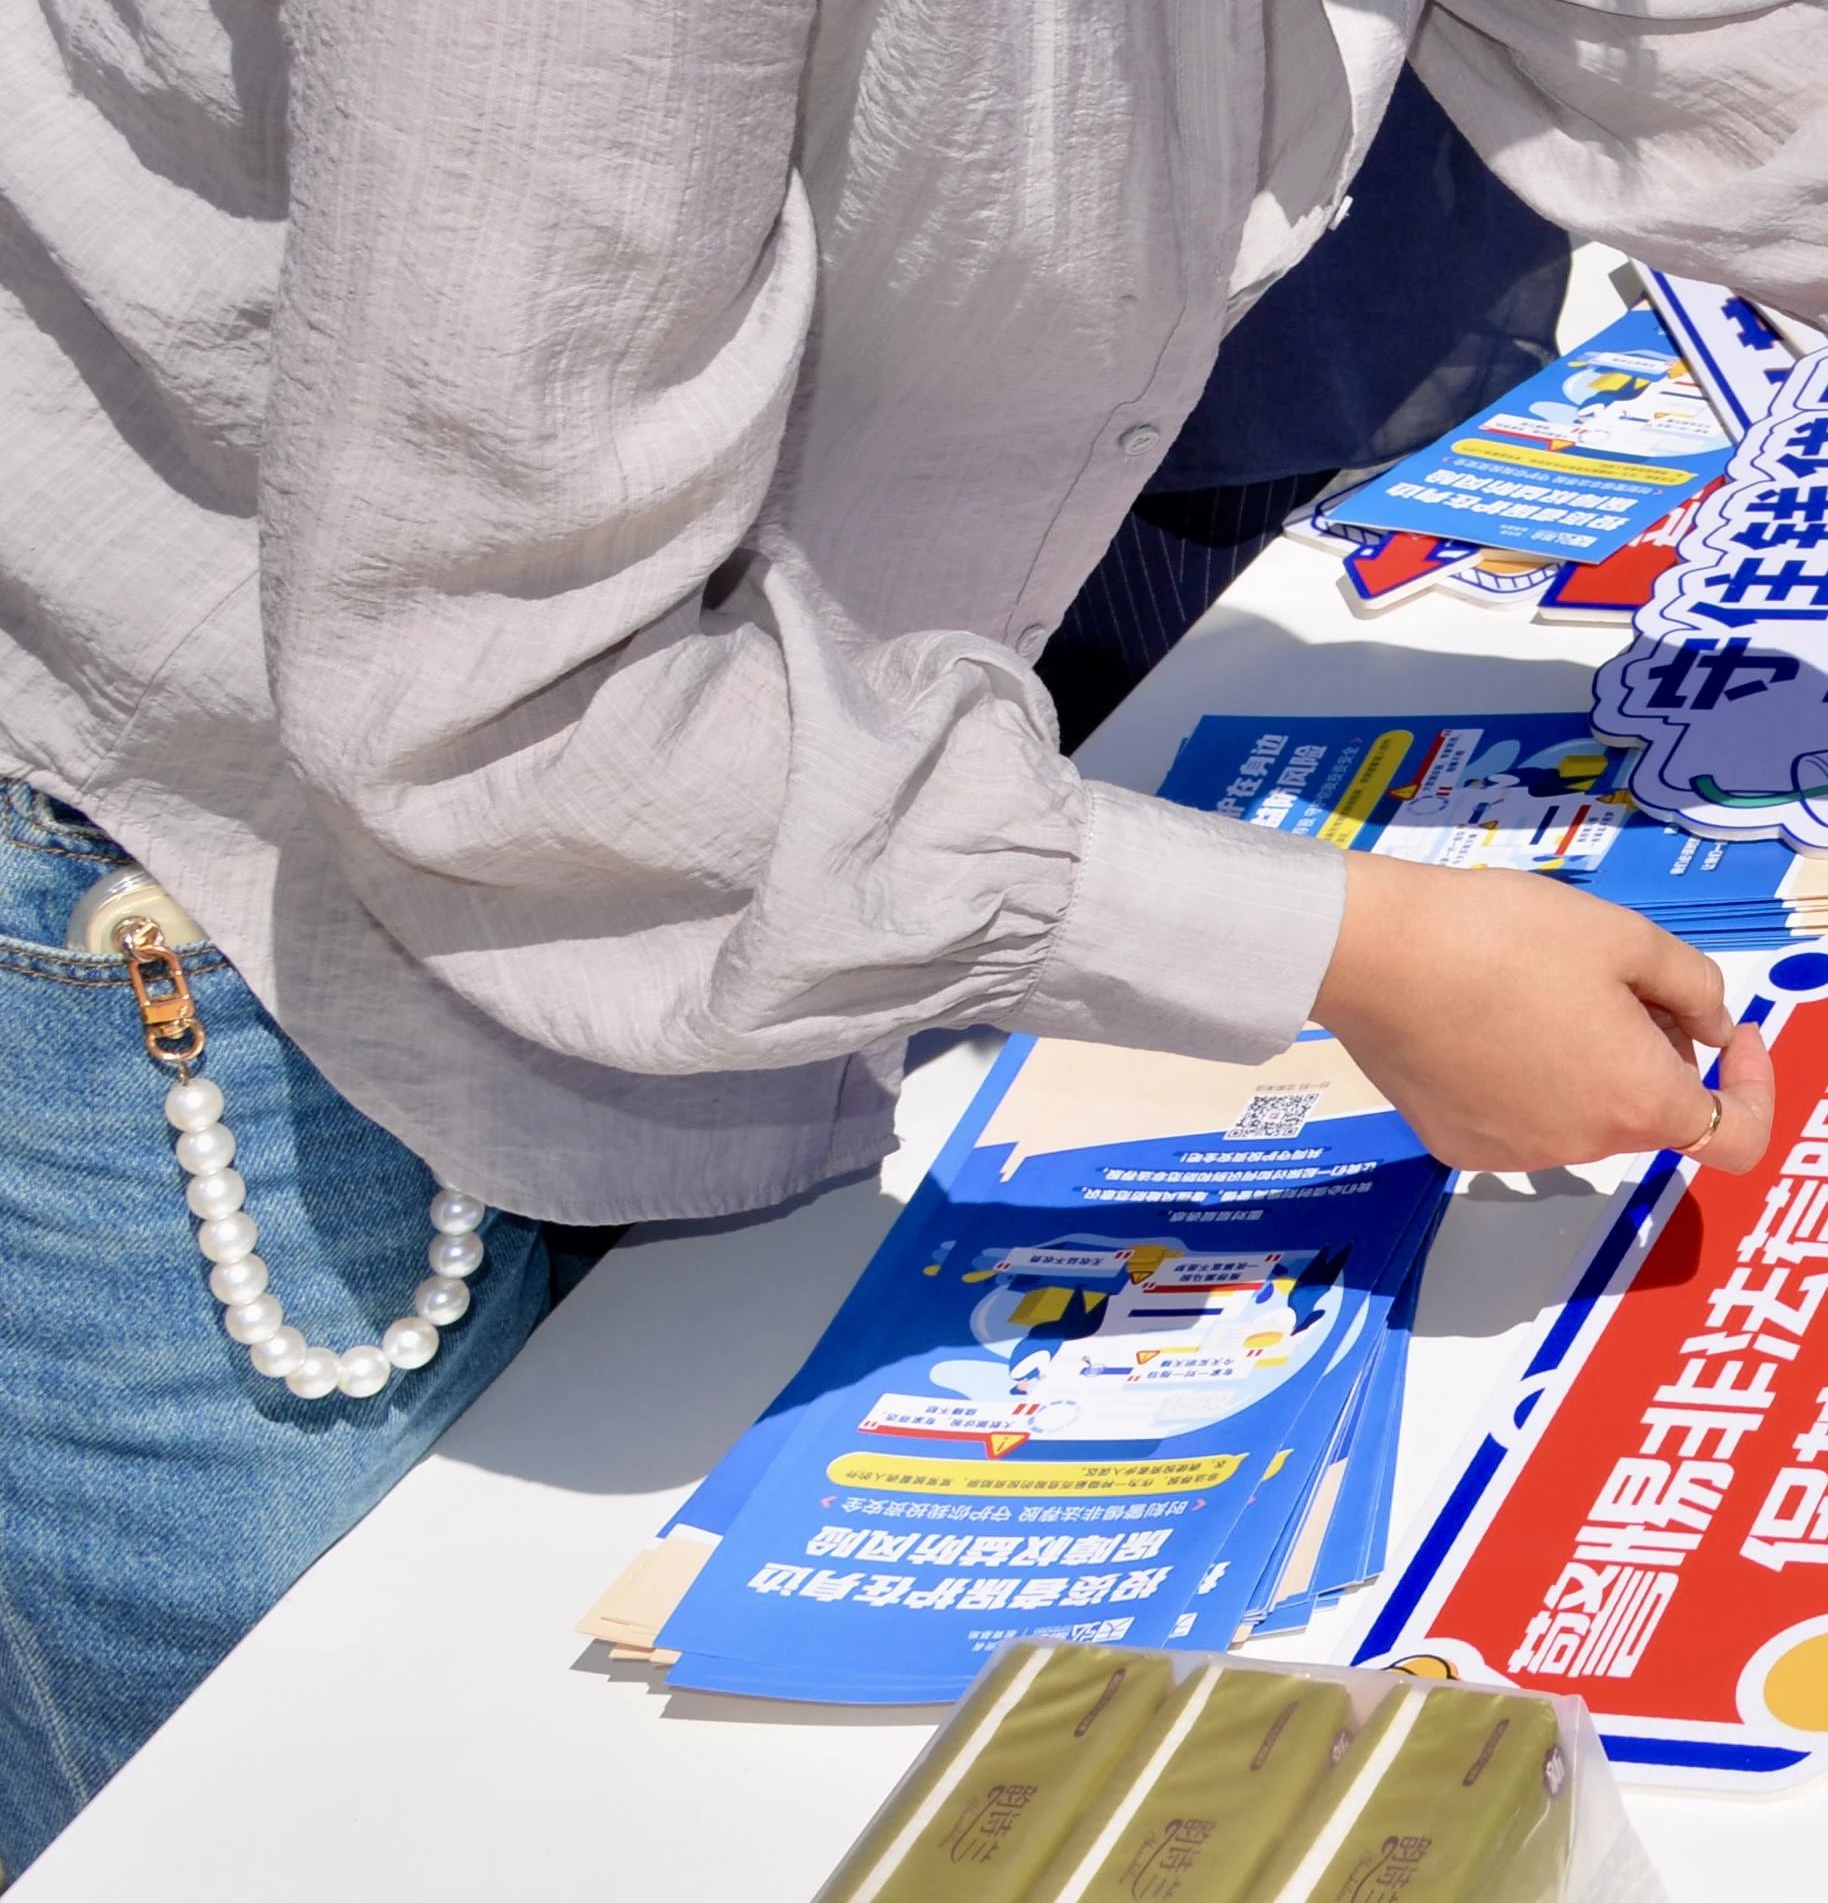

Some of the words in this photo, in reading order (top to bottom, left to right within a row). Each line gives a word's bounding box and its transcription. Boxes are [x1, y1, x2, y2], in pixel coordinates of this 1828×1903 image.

[1385, 482, 1631, 531] 投资者保护在身边
[1424, 468, 1639, 512] 保障权益防风险
[841, 1496, 1012, 1523] 守护你我投资安全
[1019, 1497, 1189, 1523] 时刻警惕非法荐股
[806, 1525, 1174, 1567] 保障权益防风险
[747, 1561, 1174, 1611] 投资者保护在身边
